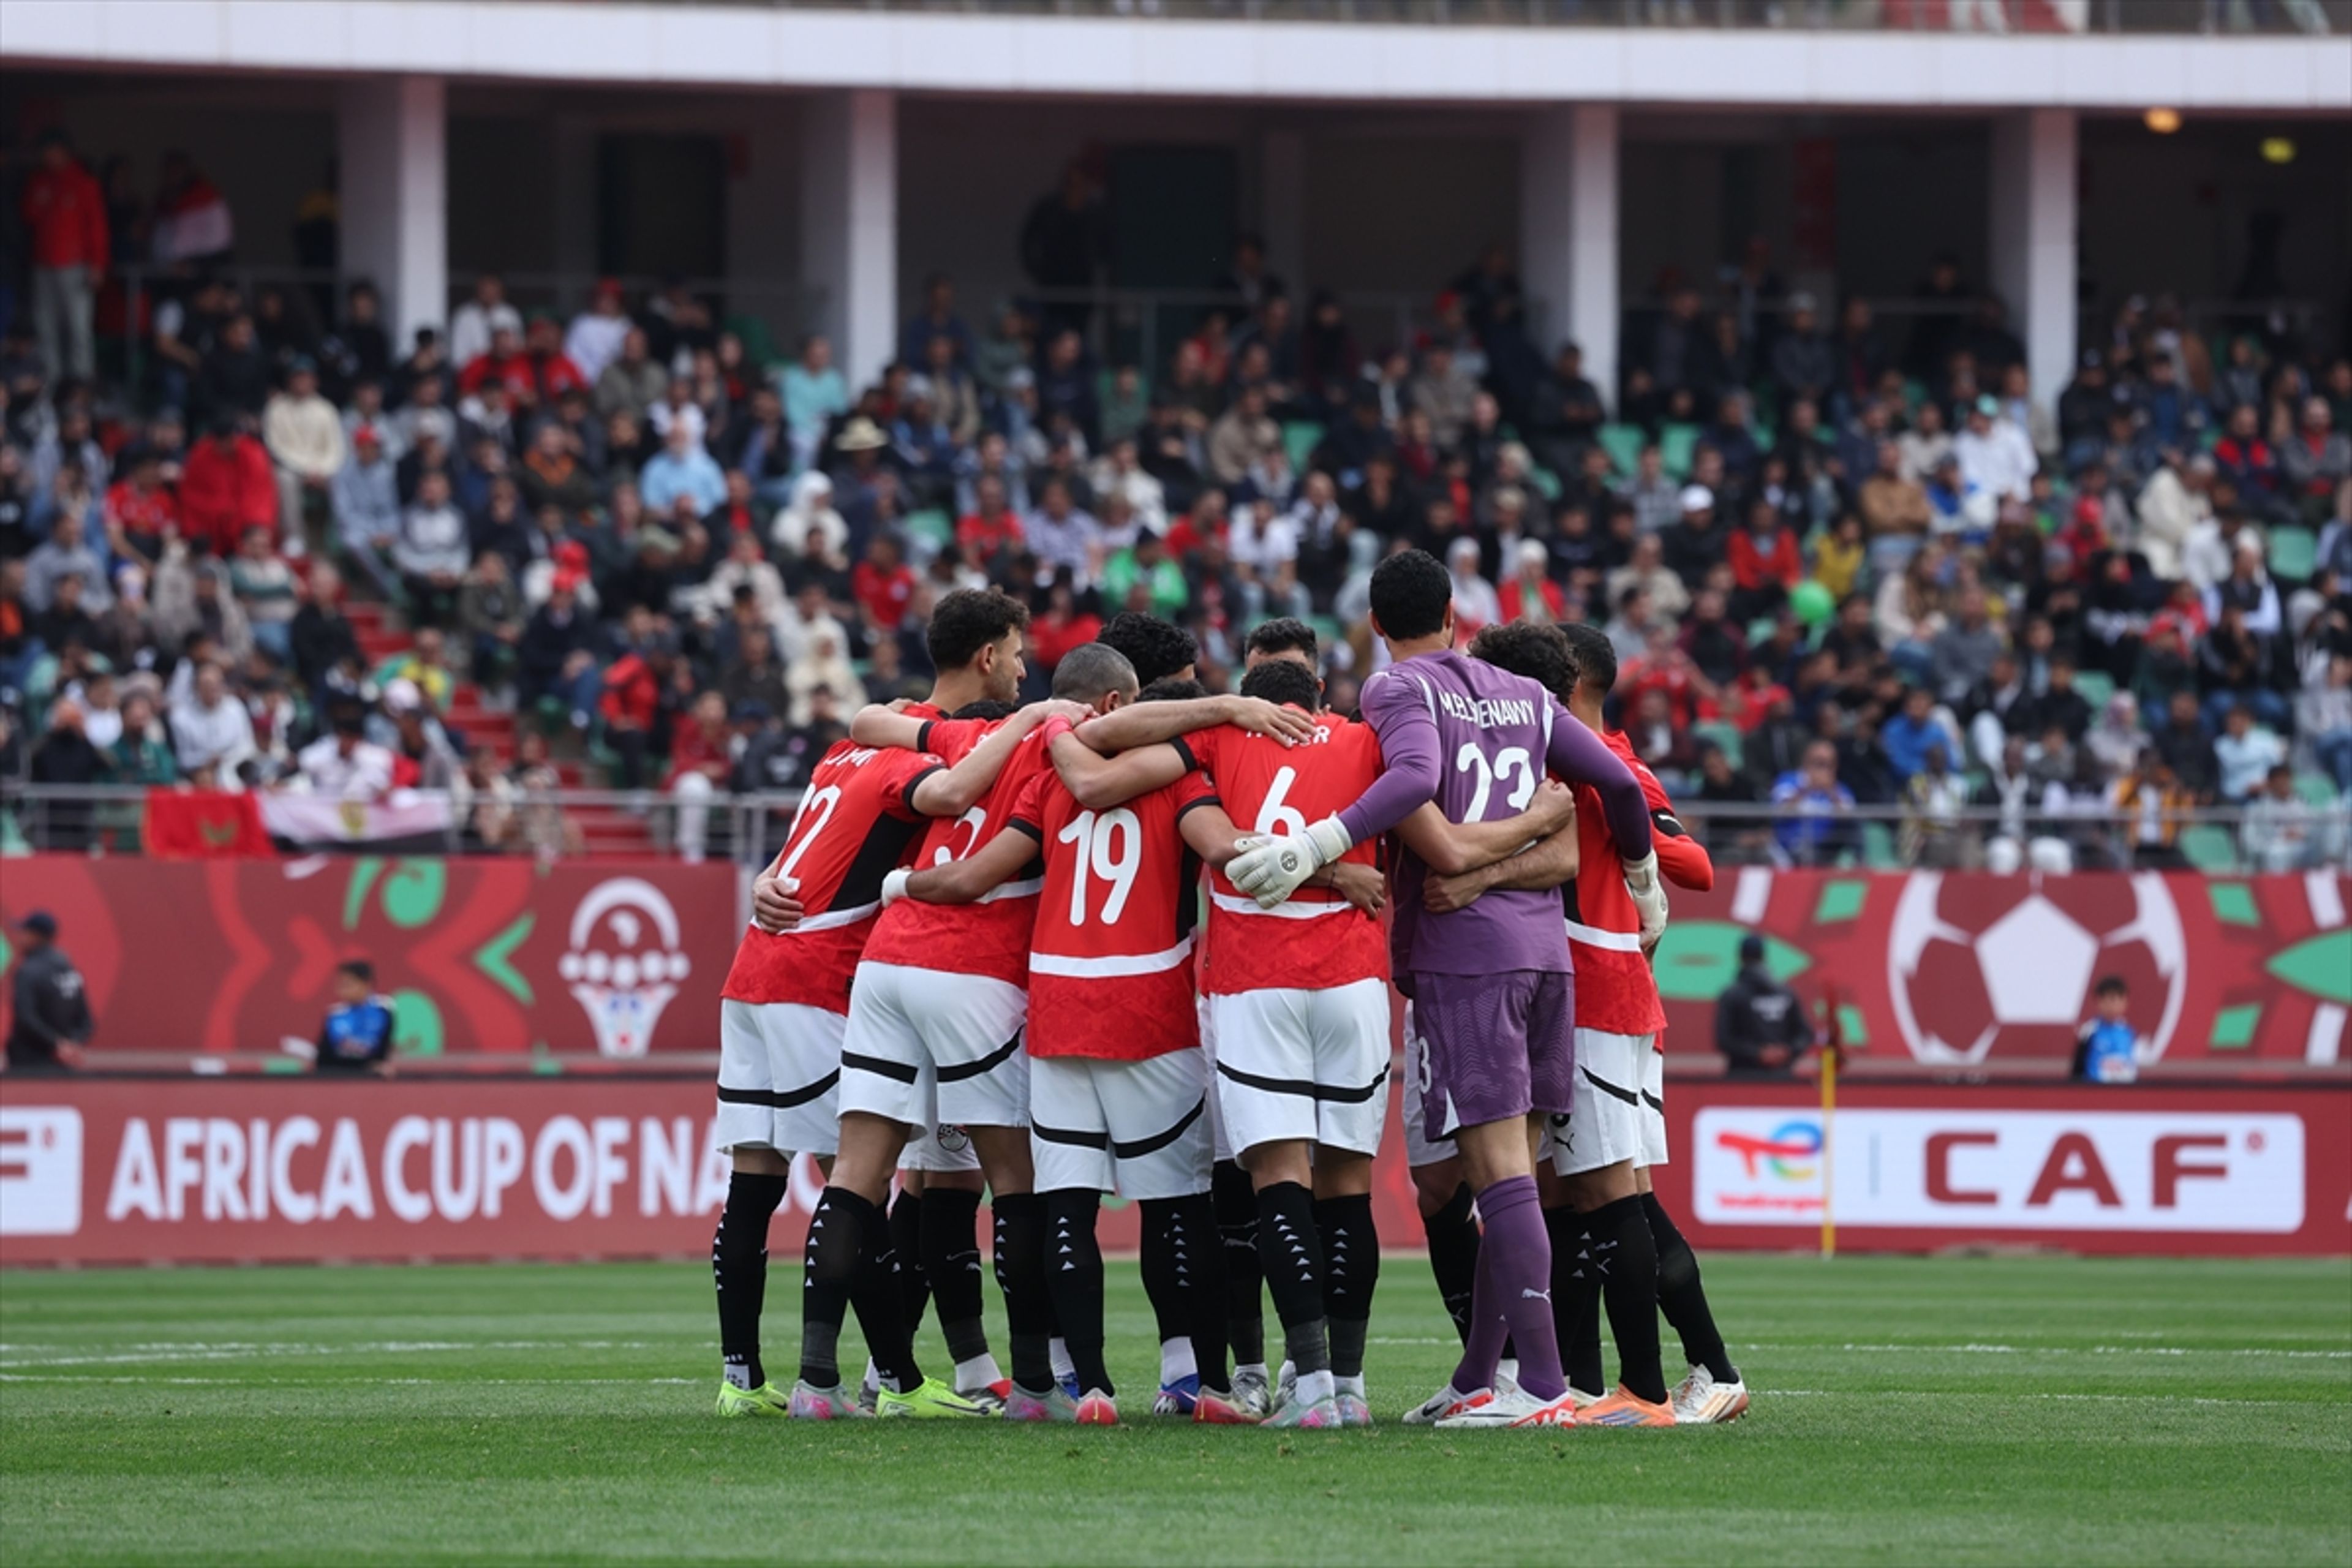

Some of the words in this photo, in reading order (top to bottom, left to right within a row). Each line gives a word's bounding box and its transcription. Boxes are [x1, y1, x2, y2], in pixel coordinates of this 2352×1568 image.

[1254, 765, 1306, 838] 6
[1058, 809, 1142, 926] 19
[107, 1115, 374, 1223] AFRICA
[382, 1115, 525, 1222] CUP
[532, 1115, 630, 1221] OF
[1924, 1131, 2228, 1208] CAF
